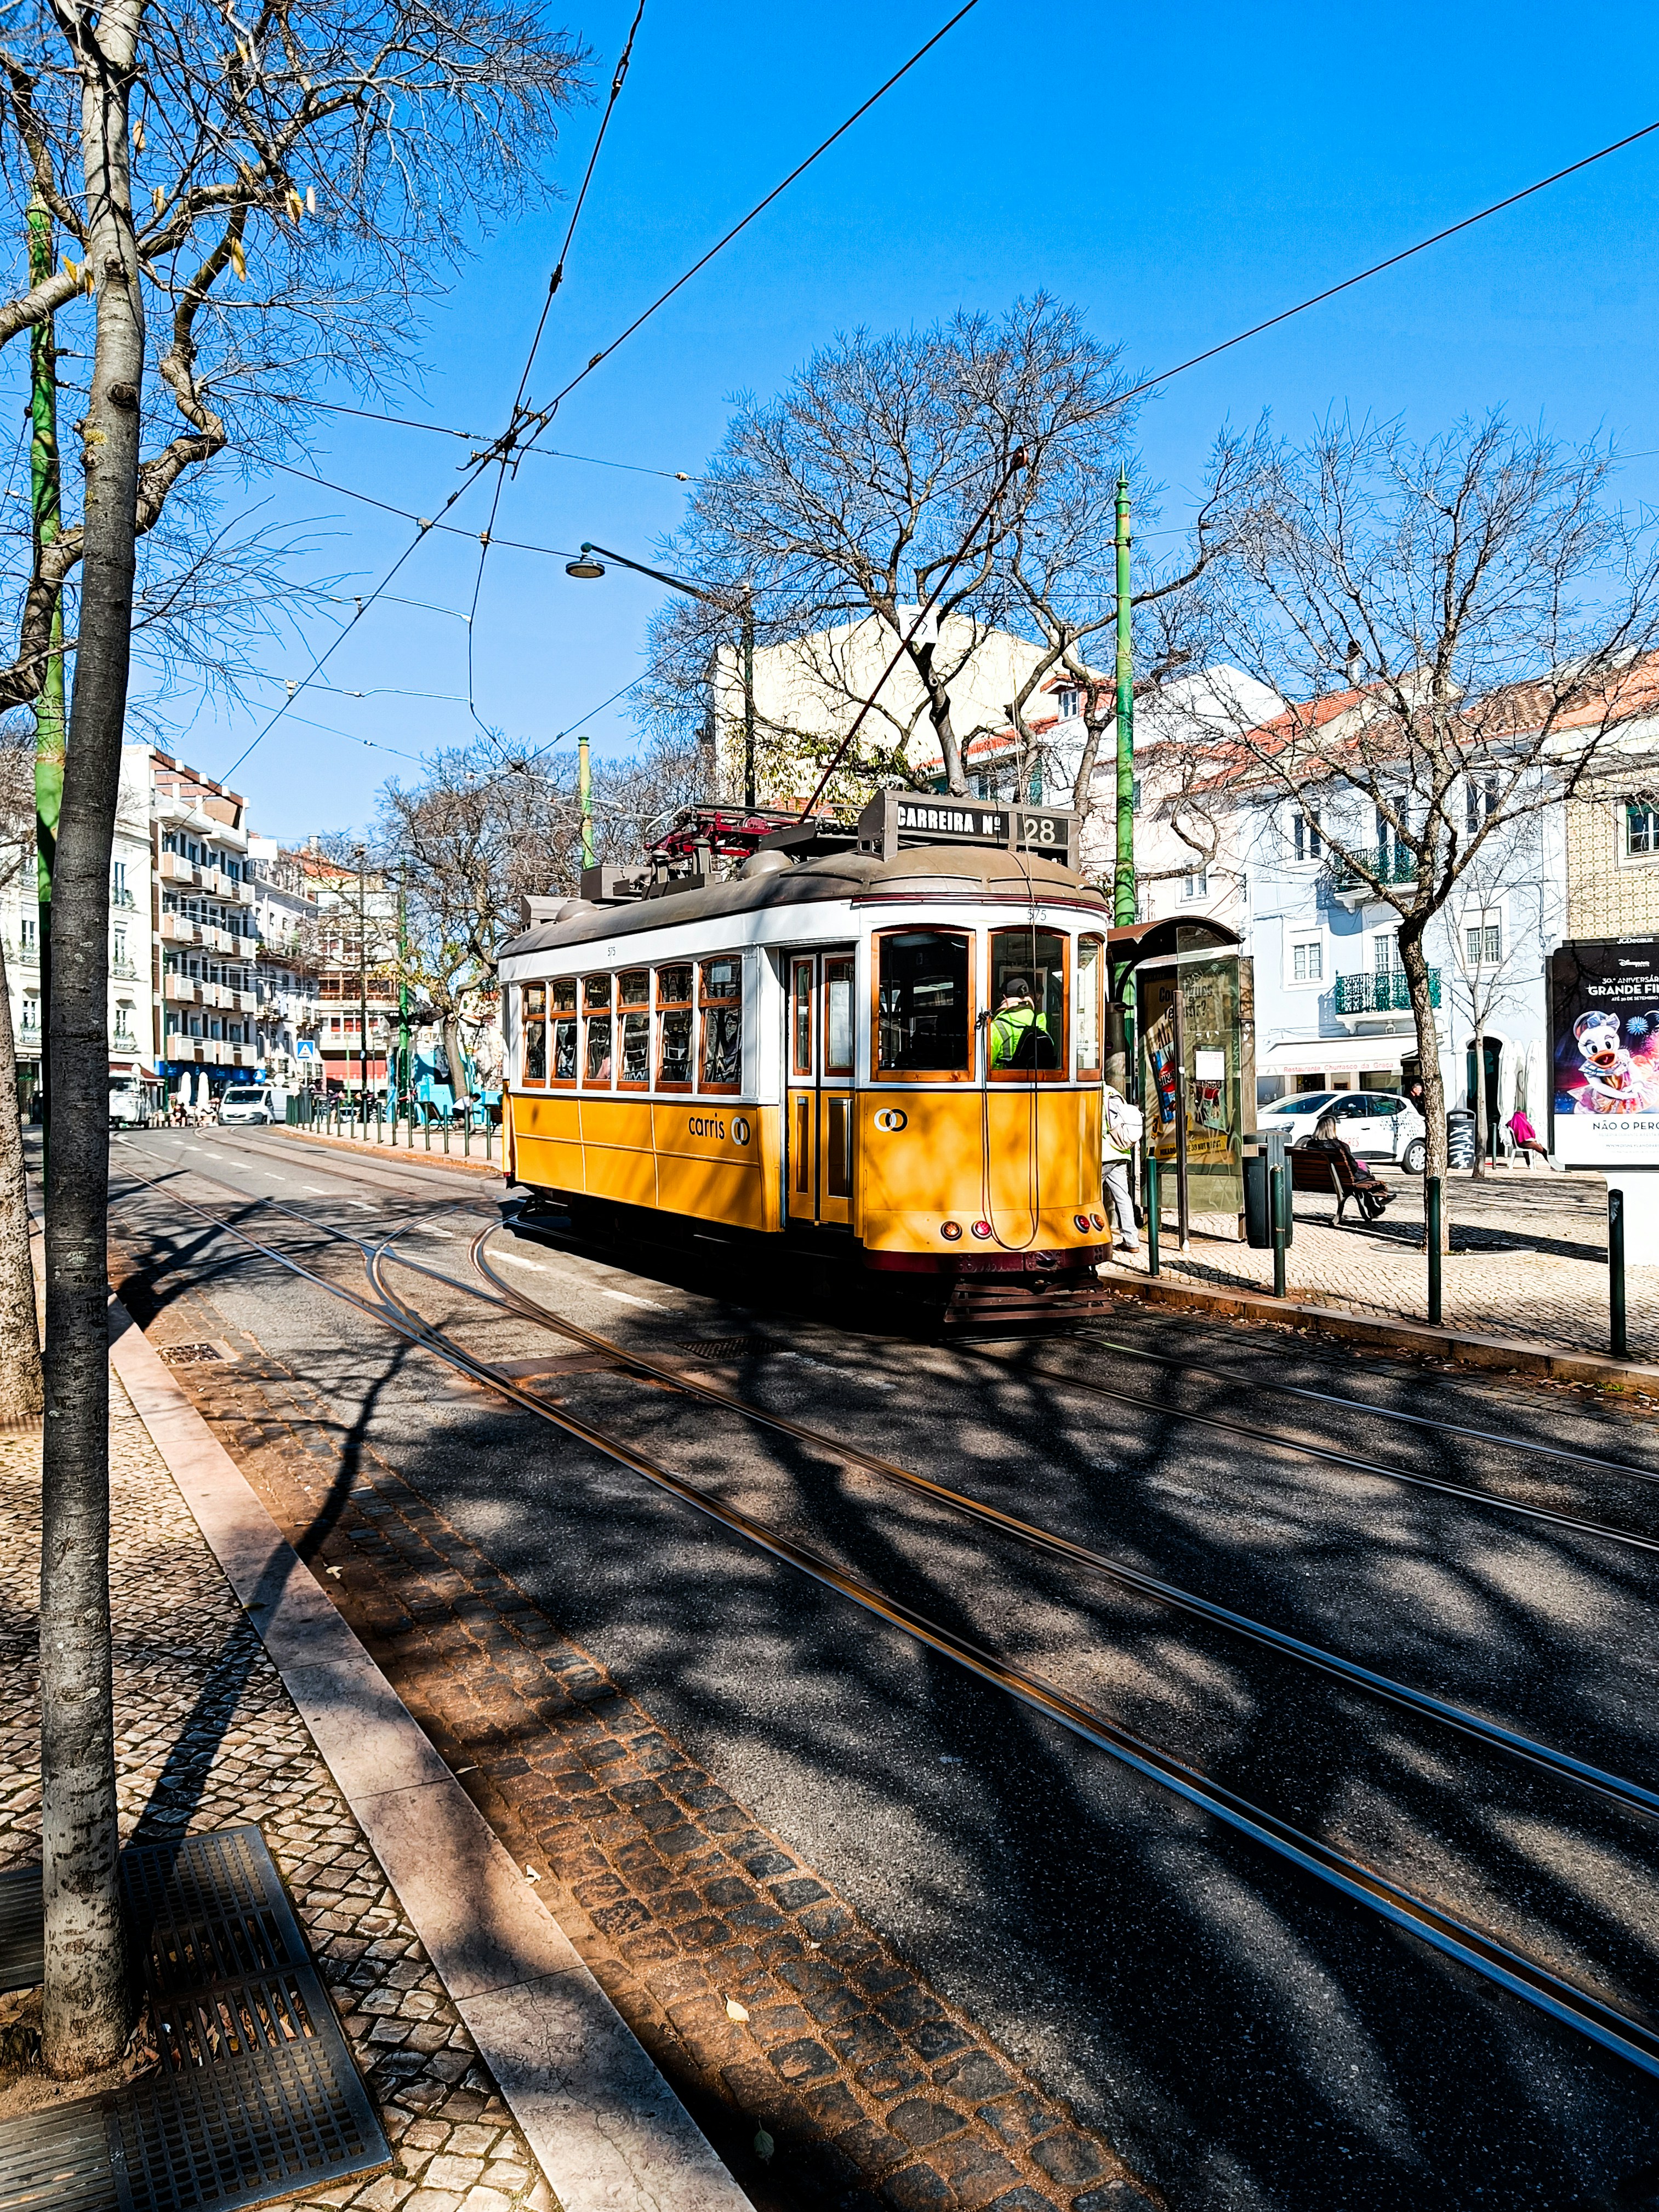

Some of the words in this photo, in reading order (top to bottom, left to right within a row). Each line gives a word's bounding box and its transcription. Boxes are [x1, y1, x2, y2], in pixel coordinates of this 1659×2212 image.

[897, 806, 974, 833] CARREIRA
[1024, 819, 1056, 844] 28
[1027, 908, 1046, 921] 575
[607, 946, 615, 957] 575
[1588, 984, 1642, 996] GRANDE
[688, 1112, 725, 1140] carris
[1593, 1120, 1617, 1130] NÃO
